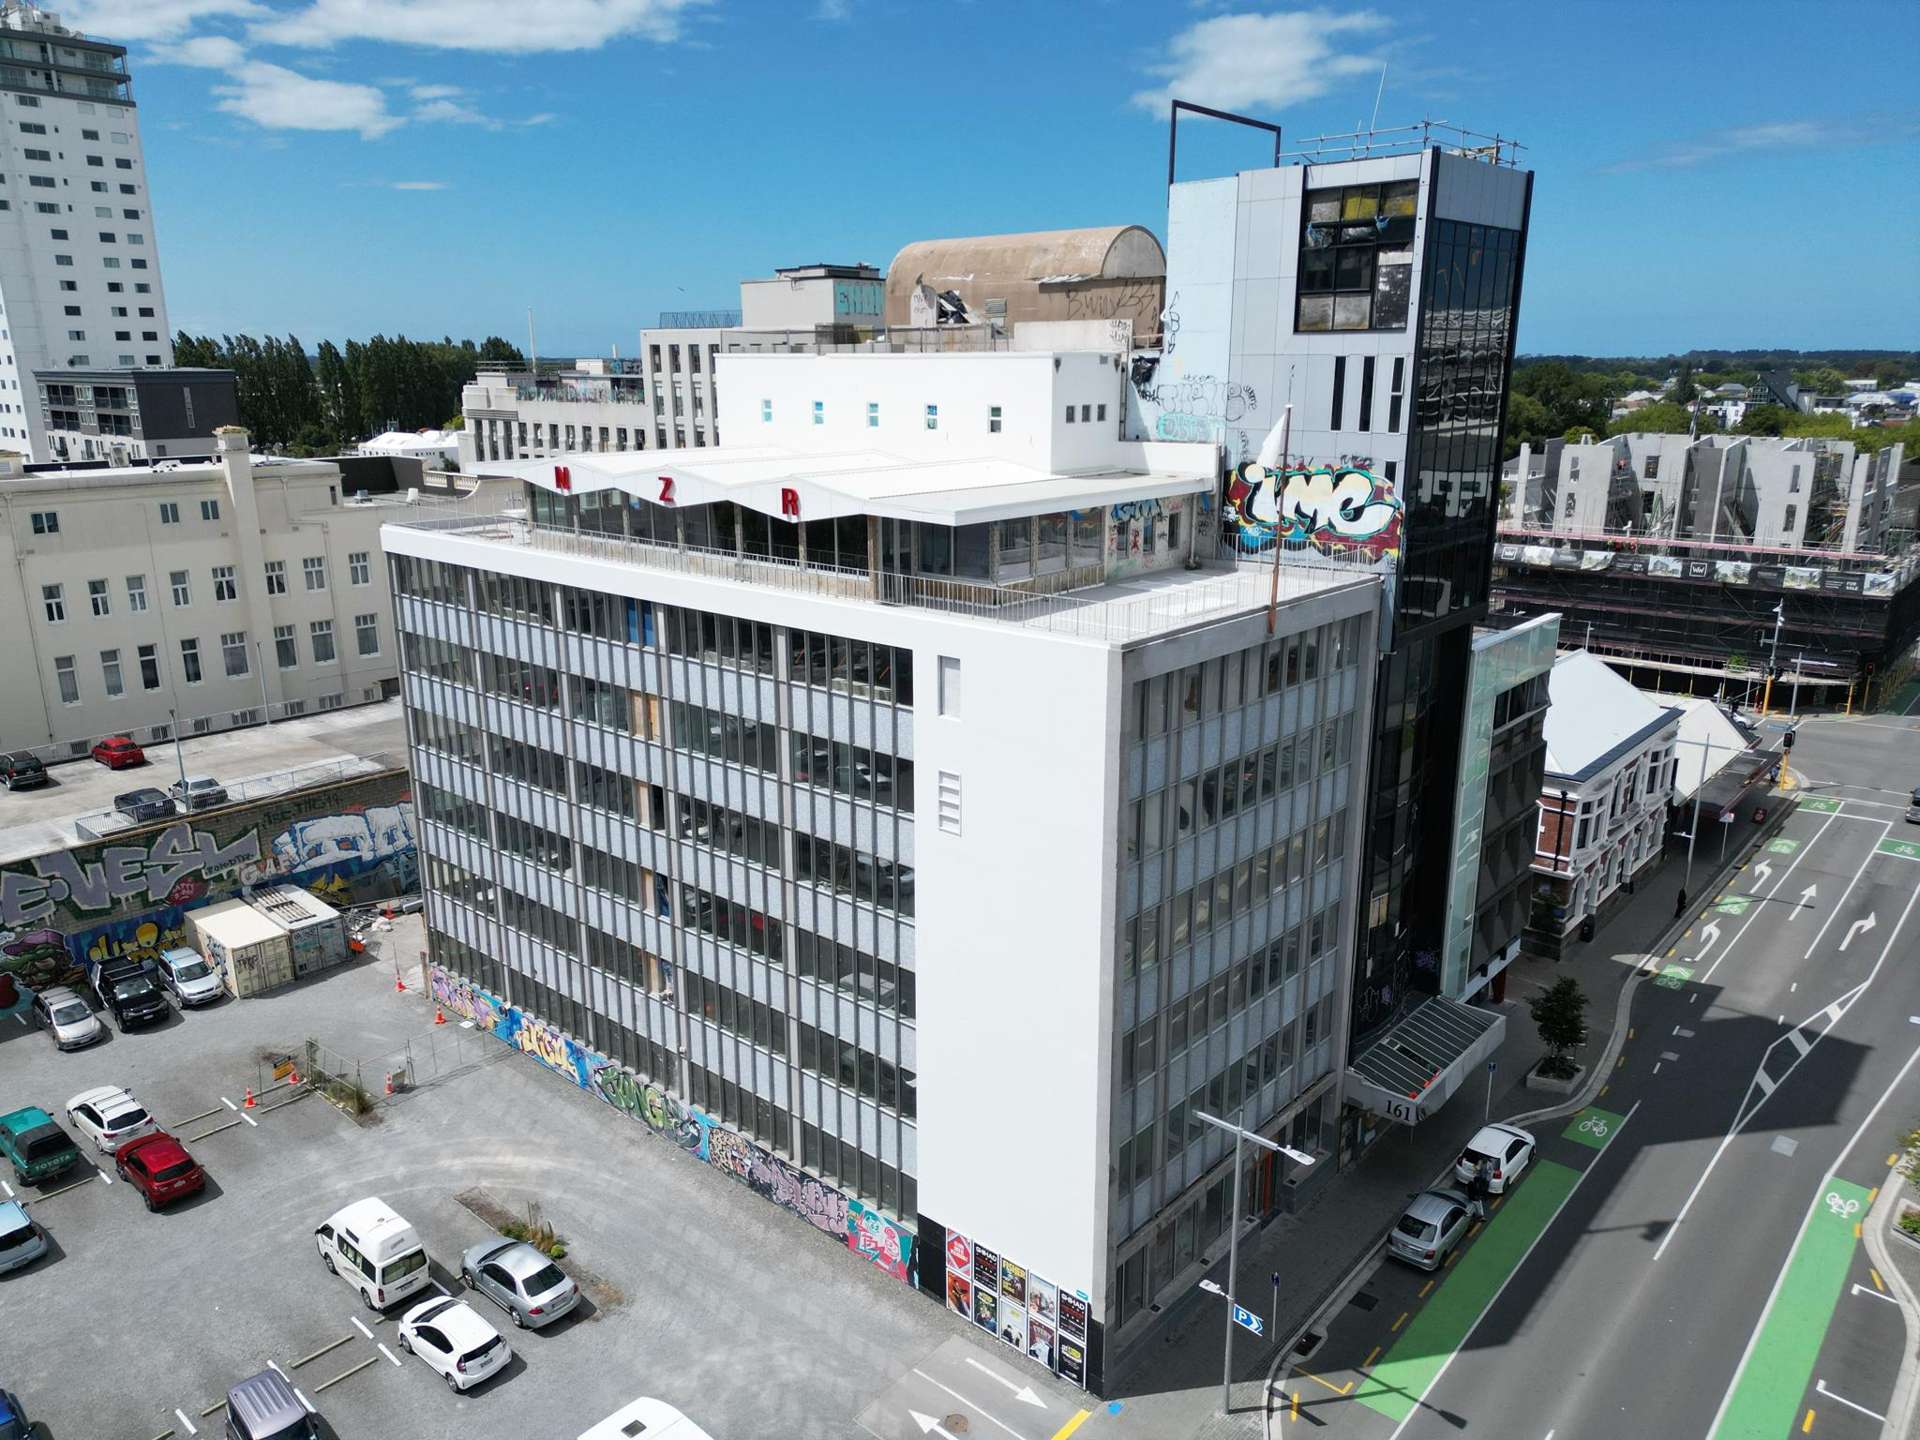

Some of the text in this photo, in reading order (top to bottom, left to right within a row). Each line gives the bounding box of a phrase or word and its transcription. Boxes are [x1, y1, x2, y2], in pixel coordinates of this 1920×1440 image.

[555, 466, 800, 516] N Z R
[1385, 1099, 1411, 1121] 161
[34, 1154, 71, 1171] TOYOTA
[1238, 1310, 1248, 1321] P
